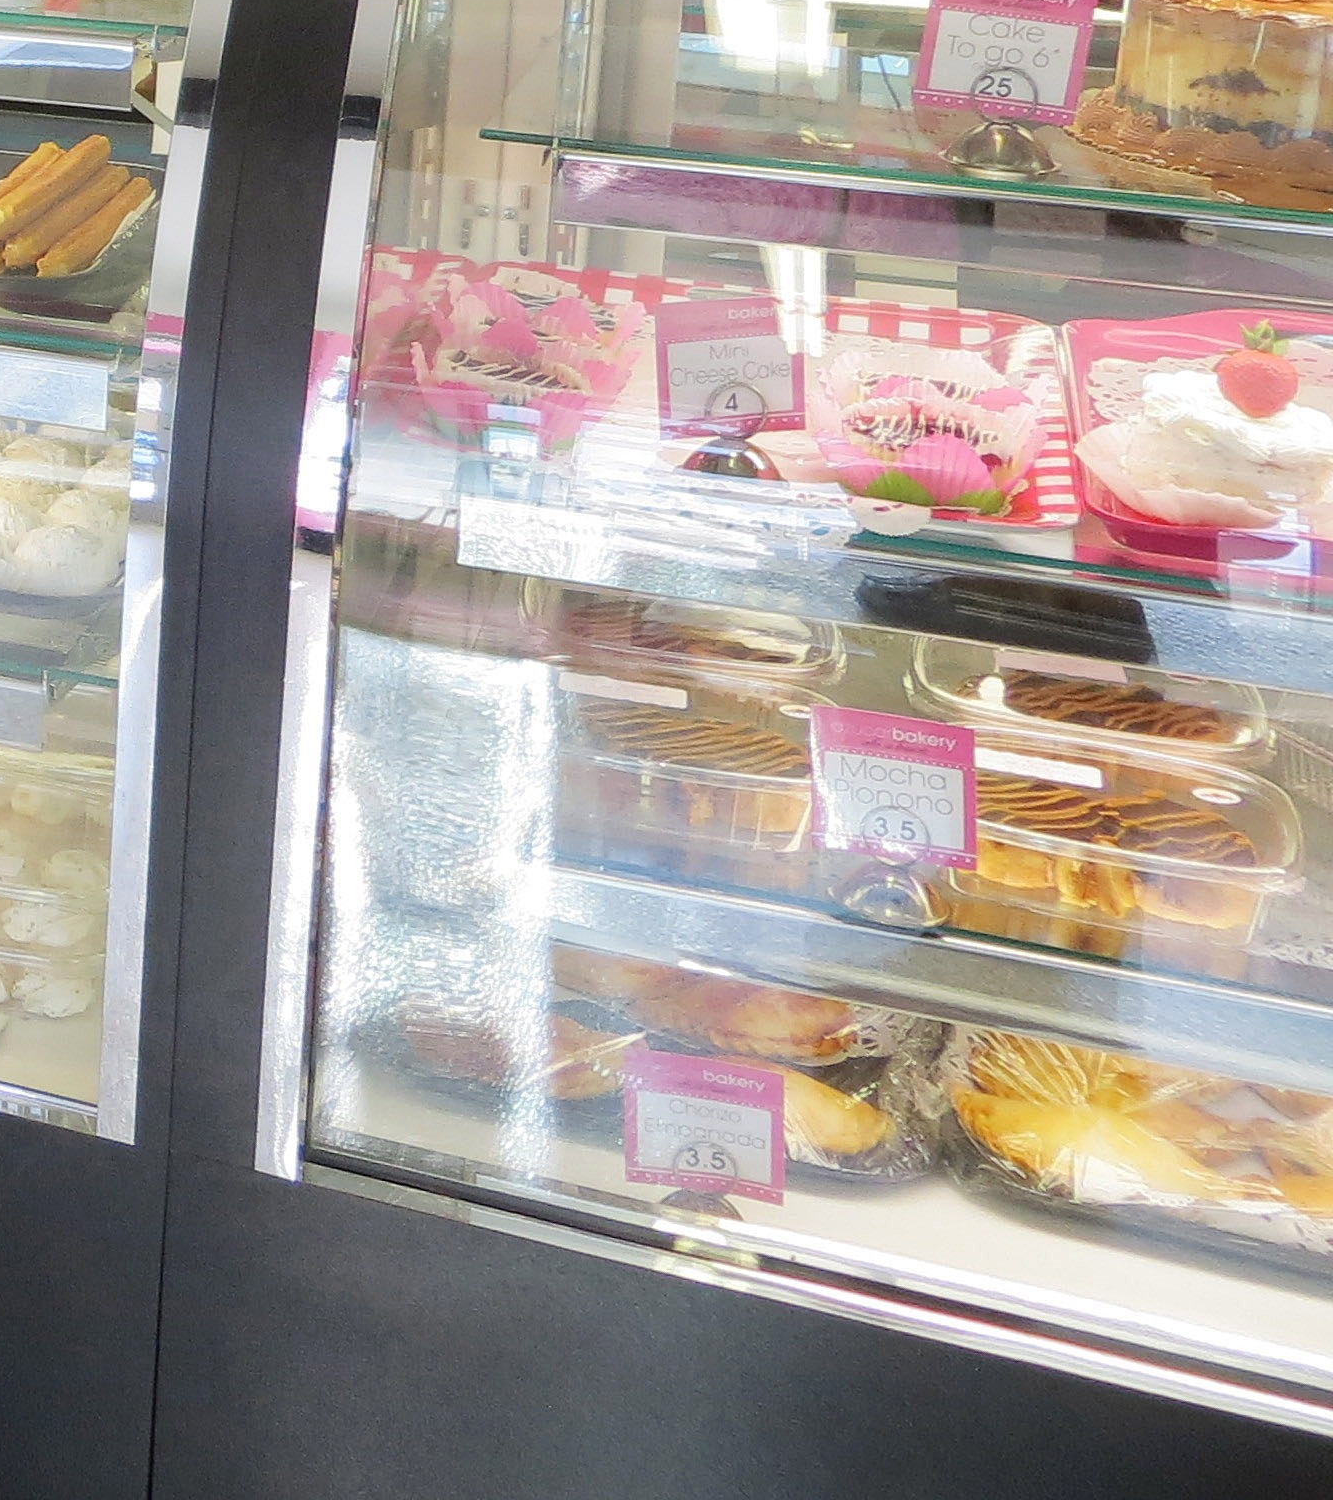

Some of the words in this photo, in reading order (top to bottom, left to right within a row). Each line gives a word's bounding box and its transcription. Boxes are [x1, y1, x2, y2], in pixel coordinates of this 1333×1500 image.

[966, 13, 1046, 44] Cake
[946, 34, 976, 59] To
[983, 44, 1024, 68] go
[978, 75, 1013, 98] 25
[709, 344, 750, 360] Mini
[670, 366, 739, 388] Cheese
[742, 360, 791, 381] Cake
[724, 392, 739, 411] 4
[839, 754, 948, 791] Mocha
[830, 777, 954, 816] Pionono
[873, 816, 917, 841] 3.5
[668, 1099, 743, 1125] Chorizo
[643, 1115, 768, 1151] Empanada
[684, 1146, 727, 1170] 3.5
